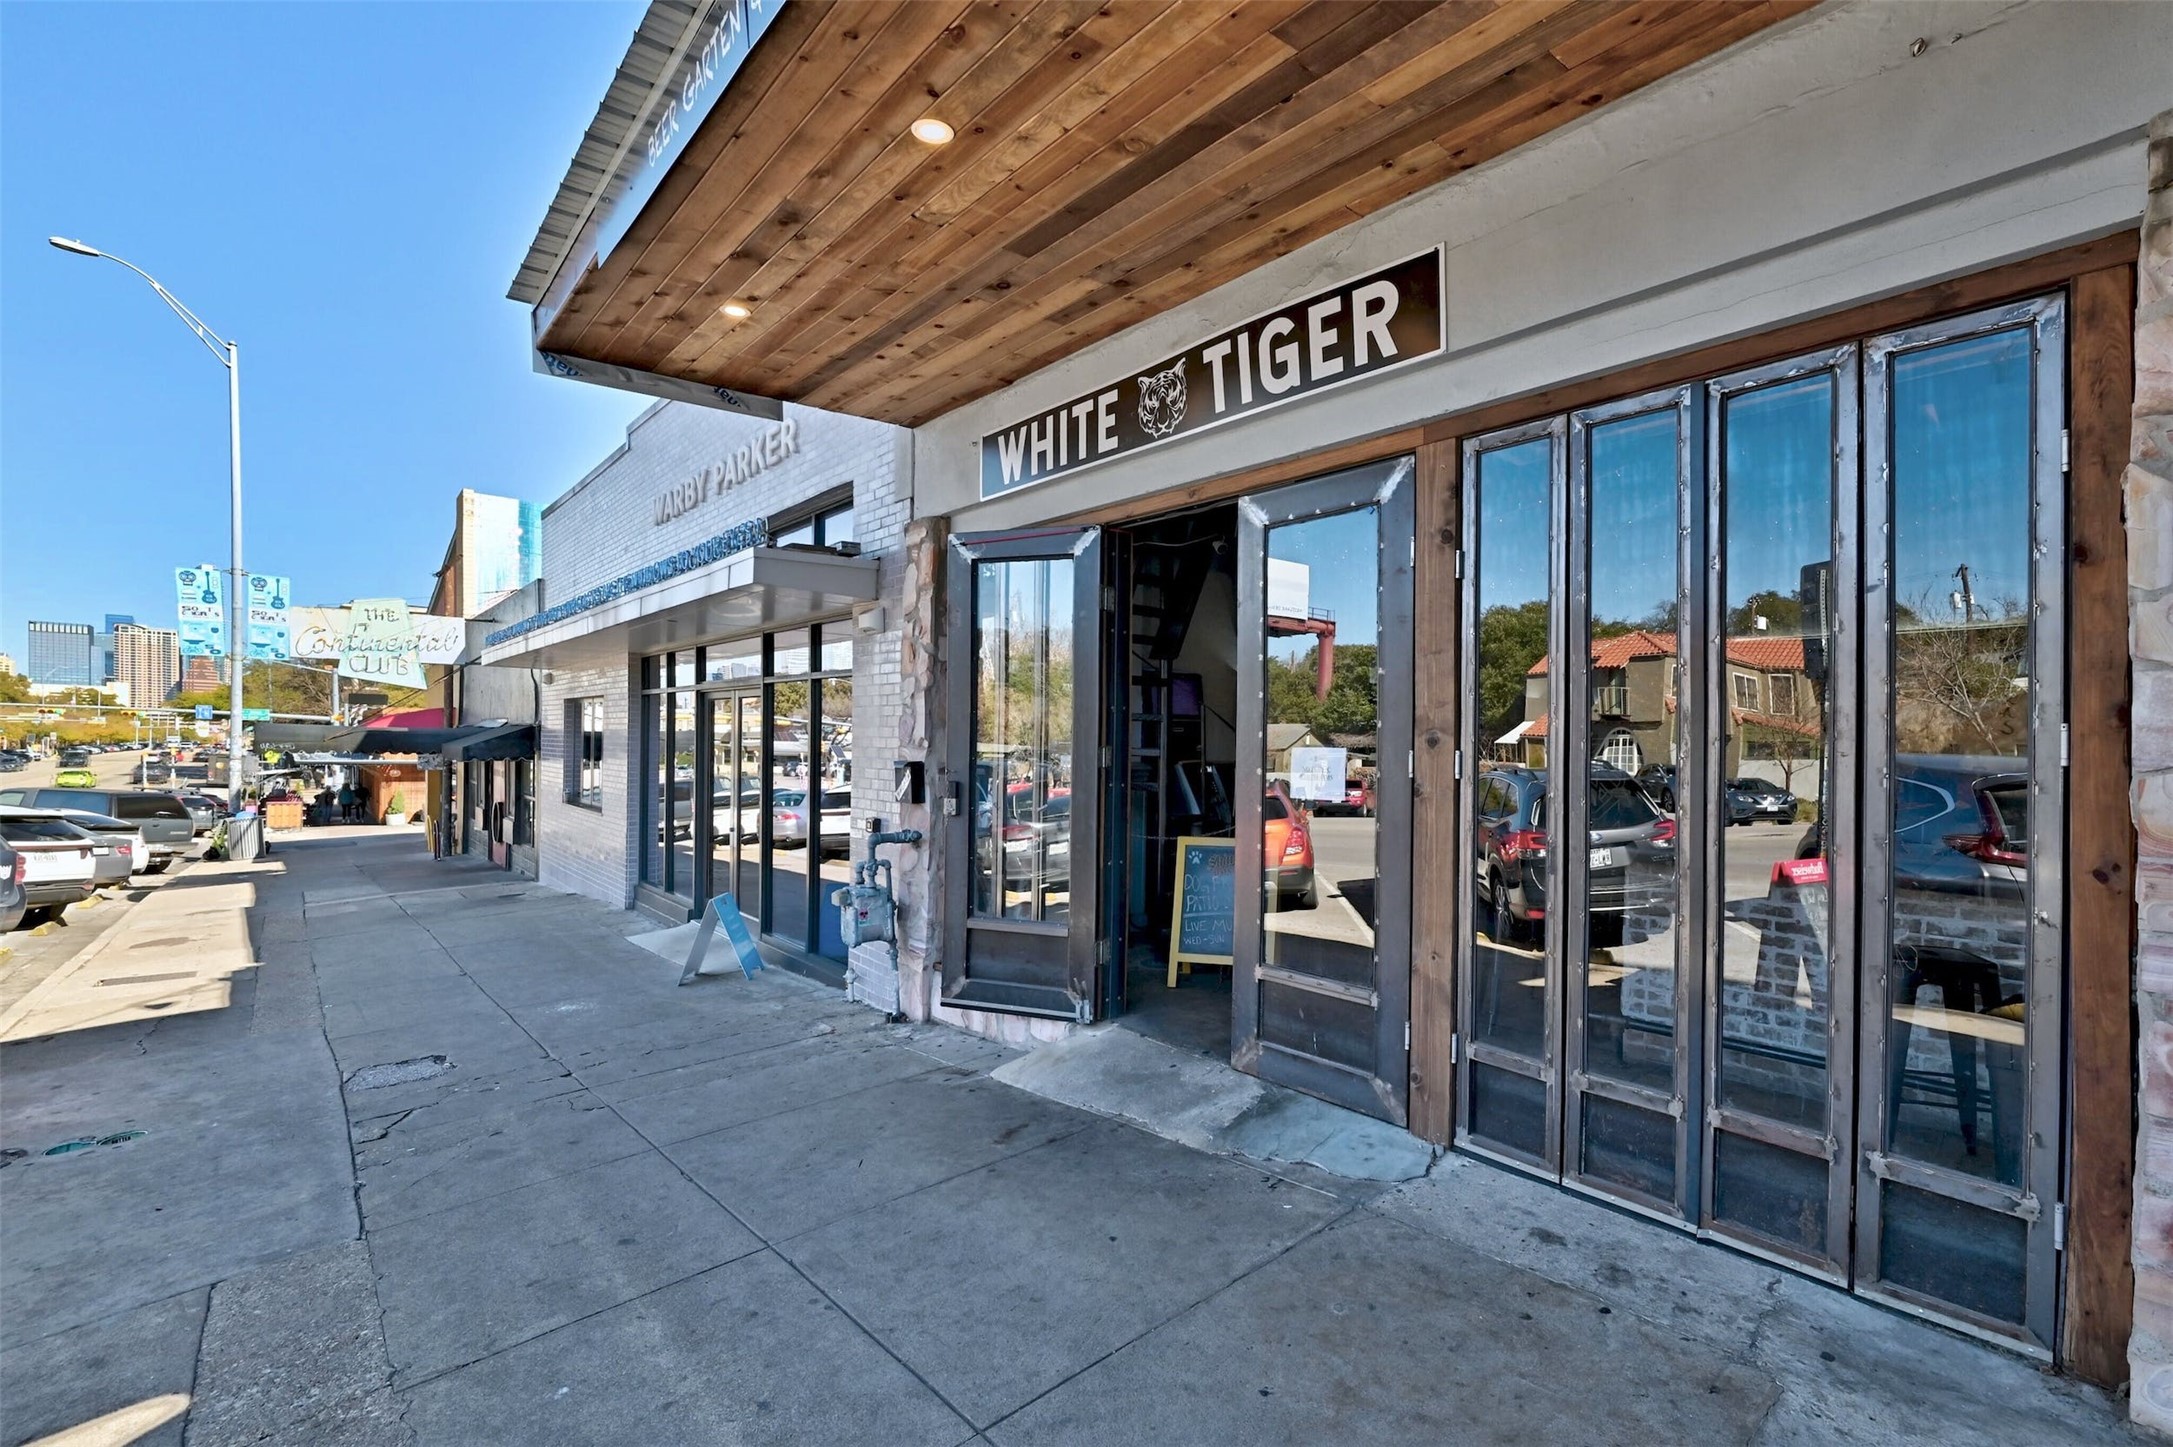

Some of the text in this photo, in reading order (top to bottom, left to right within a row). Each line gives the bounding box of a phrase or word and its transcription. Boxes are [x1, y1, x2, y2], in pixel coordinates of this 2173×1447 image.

[648, 0, 741, 168] BEER GARTEN
[997, 280, 1400, 485] WHITE TIGER
[653, 417, 800, 526] WARBY PARKER
[364, 608, 399, 622] THE
[295, 623, 459, 657] Continental
[349, 653, 409, 676] CLUB
[1185, 920, 1207, 932] LIVE
